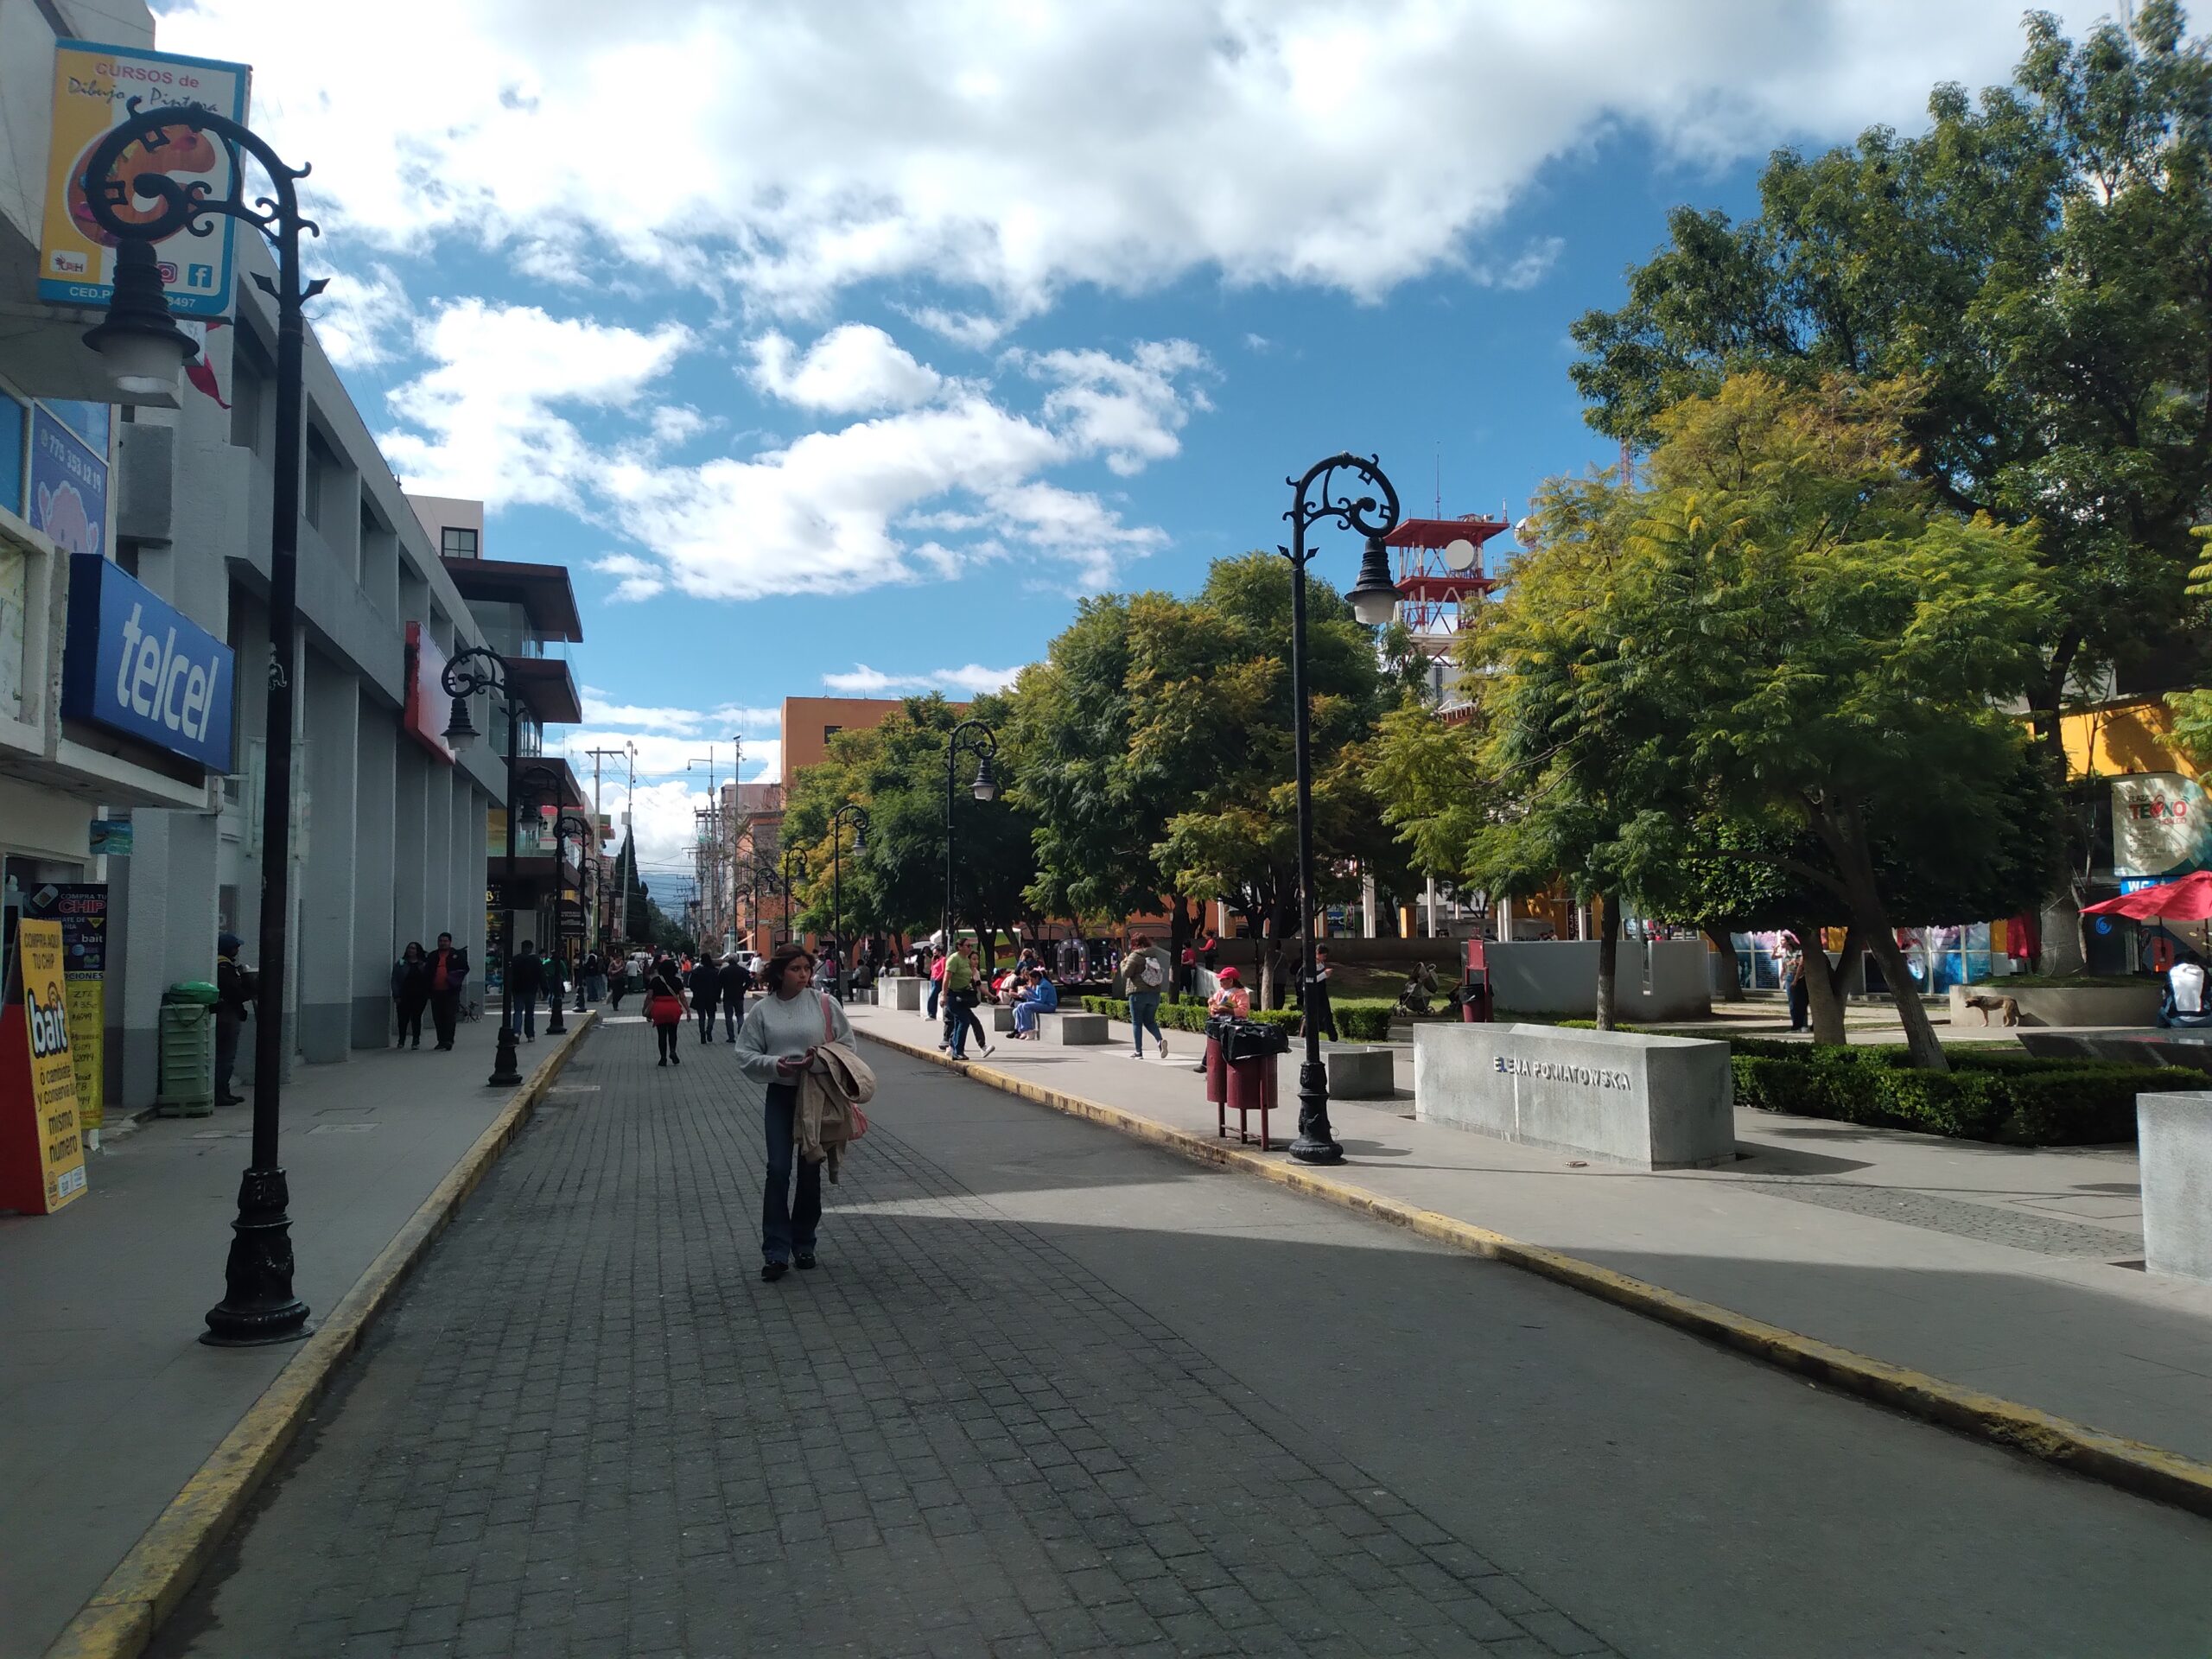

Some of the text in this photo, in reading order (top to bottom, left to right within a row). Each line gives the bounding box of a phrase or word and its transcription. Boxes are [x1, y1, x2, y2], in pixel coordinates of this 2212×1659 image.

[95, 62, 200, 88] CURSOS de
[67, 76, 125, 105] Dibujo
[69, 286, 113, 299] CED.P
[49, 434, 65, 462] 775
[83, 463, 92, 485] 12
[92, 470, 102, 493] 19
[117, 602, 219, 743] telcel
[2129, 794, 2150, 803] PLAZA
[59, 899, 107, 913] CHIP
[81, 933, 104, 944] bait
[33, 953, 55, 969] TU CHIP
[28, 988, 68, 1057] bait
[1493, 1056, 1631, 1091] ELENA PONIATOWSKA
[38, 1092, 43, 1112] y
[48, 1109, 73, 1136] mismo
